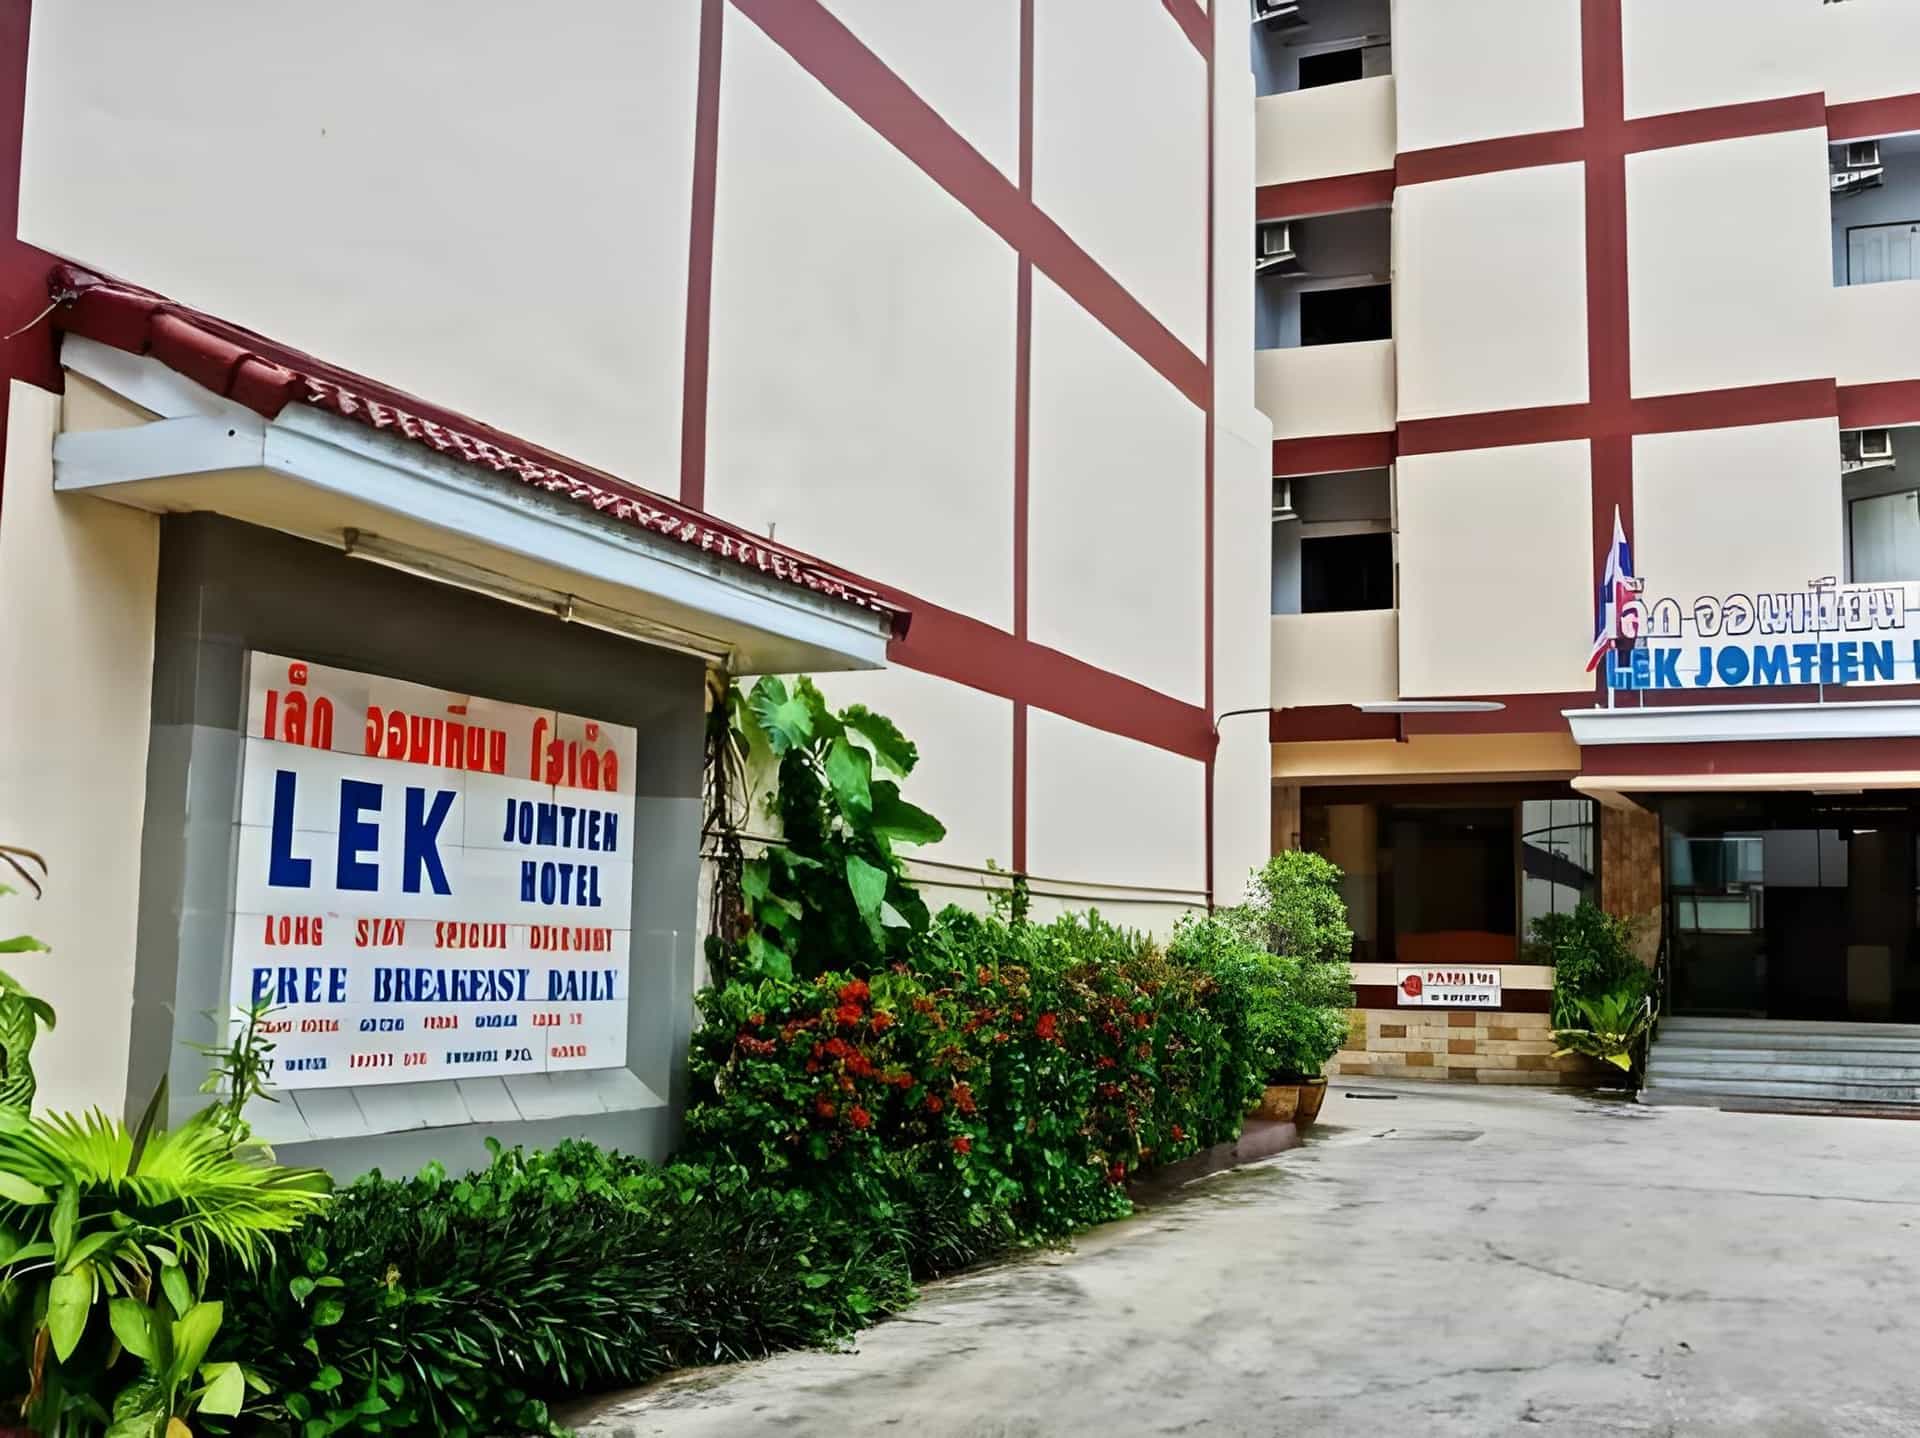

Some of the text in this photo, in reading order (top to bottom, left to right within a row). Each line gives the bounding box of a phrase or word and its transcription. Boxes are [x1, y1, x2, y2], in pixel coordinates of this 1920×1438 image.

[1695, 640, 1894, 686] JOMTIEN
[268, 769, 456, 895] LEK
[503, 798, 618, 852] JOMTIEN
[520, 860, 602, 908] HOTEL
[264, 915, 323, 946] LONG
[252, 967, 618, 1005] FREE BREAKFAST DAILY
